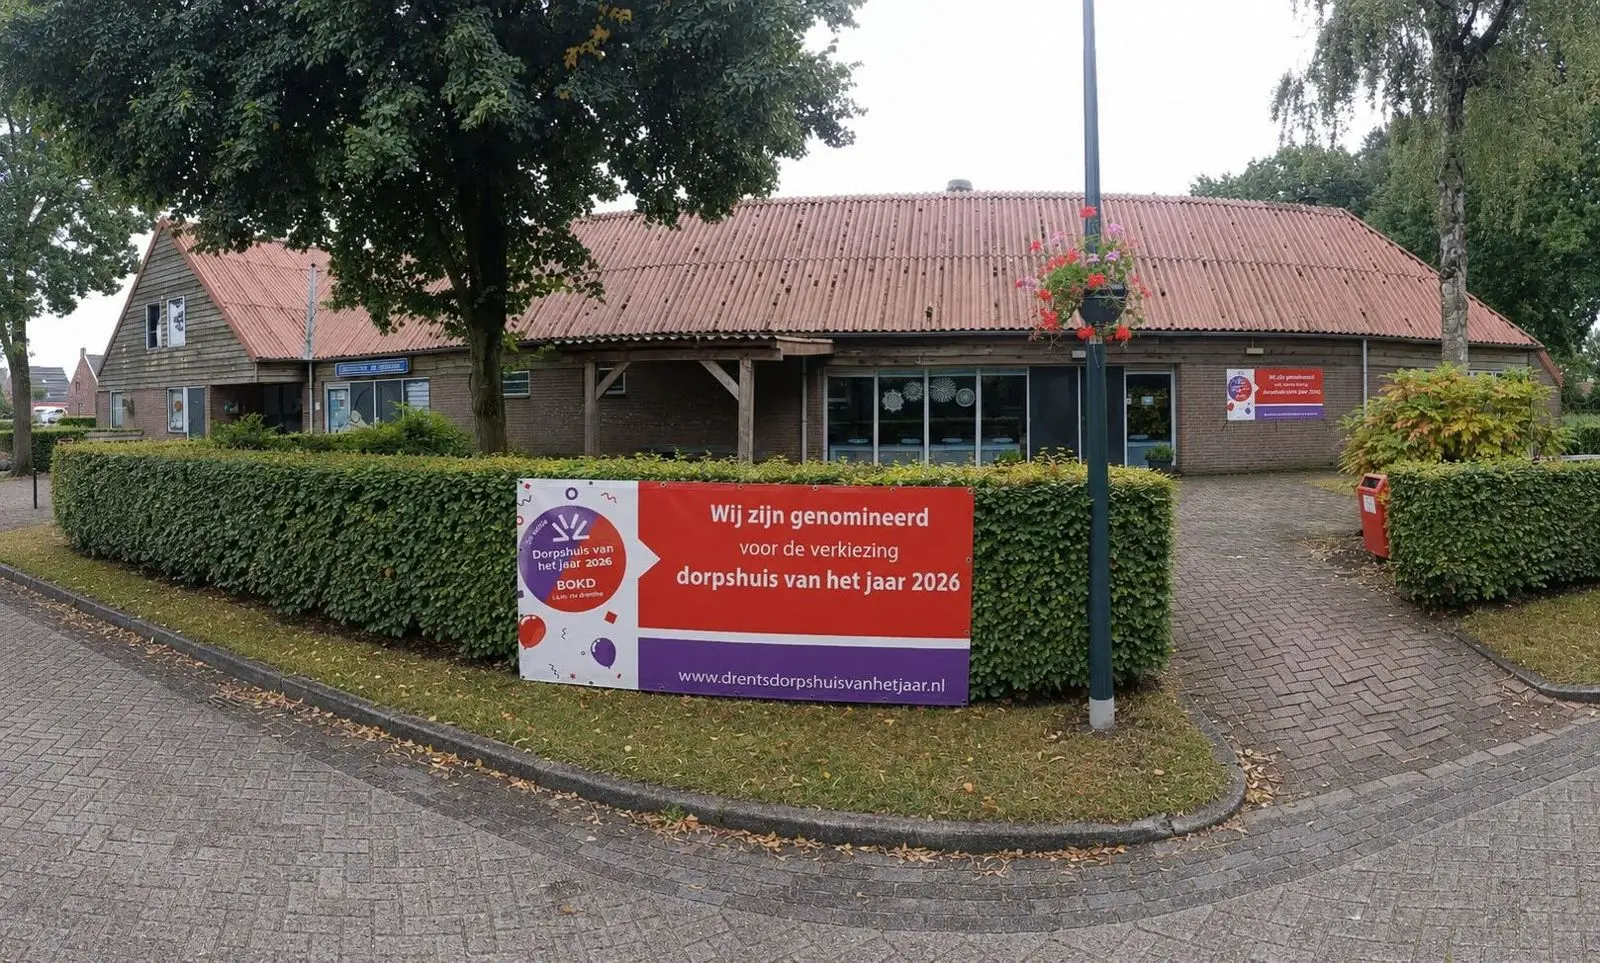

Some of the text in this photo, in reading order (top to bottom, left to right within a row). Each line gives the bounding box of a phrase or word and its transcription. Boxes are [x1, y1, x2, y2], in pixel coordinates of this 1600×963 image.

[711, 504, 929, 530] Wij zijn genomineerd
[532, 545, 614, 559] Dorpshuis van
[739, 539, 899, 563] voor de verkiezing
[538, 556, 613, 572] het jaar 2026
[556, 578, 596, 590] BOKD
[676, 565, 961, 596] dorpshuis van het jaar 2026
[678, 671, 945, 694] www.drentsdorpshuisvanhetjaar.nl
